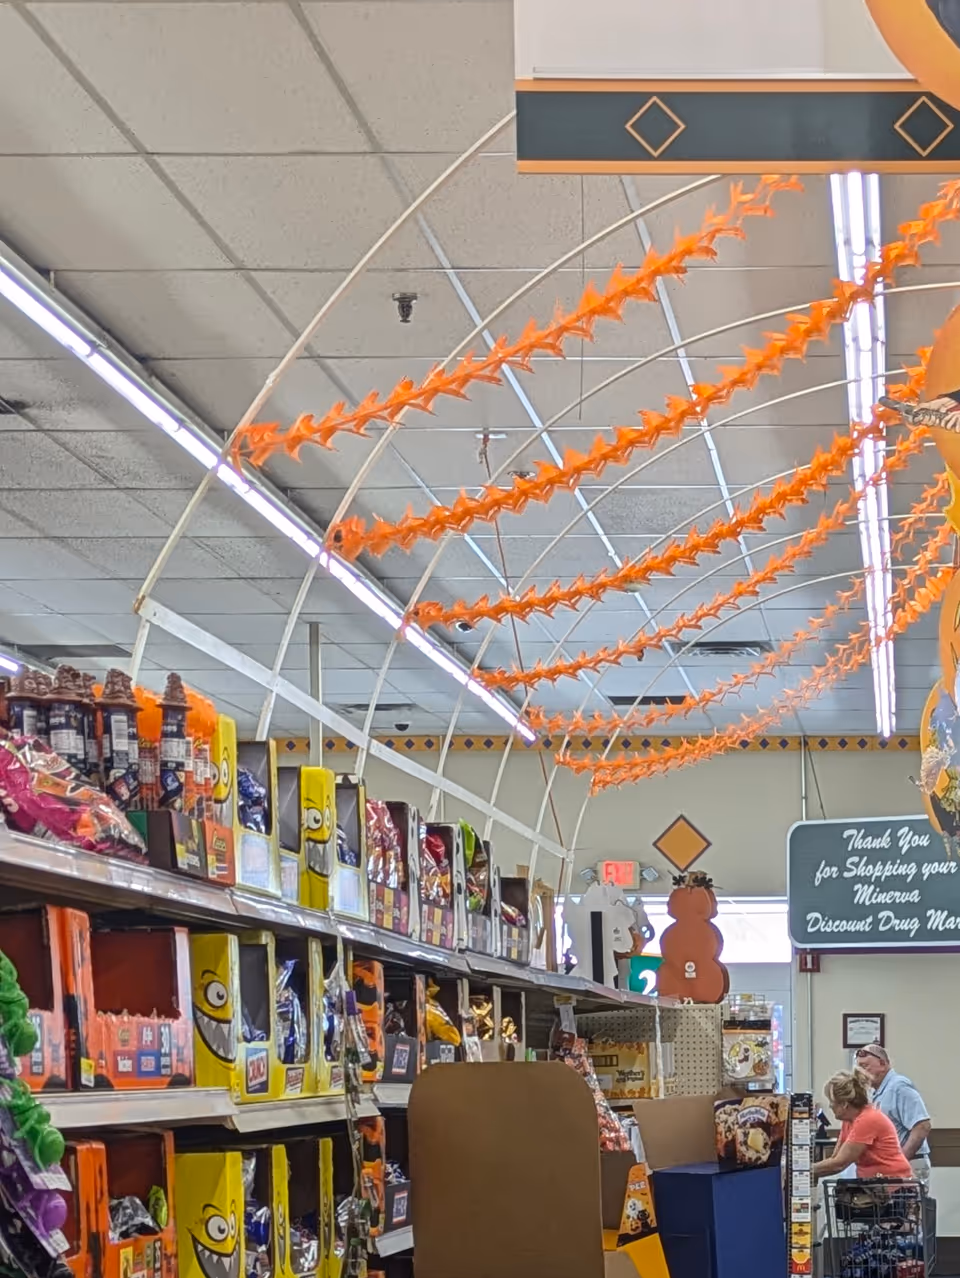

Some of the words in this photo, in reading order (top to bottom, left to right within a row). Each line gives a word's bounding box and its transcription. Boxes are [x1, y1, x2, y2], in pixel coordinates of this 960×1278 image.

[843, 828, 891, 851] Thank
[897, 827, 930, 855] You
[815, 860, 839, 886] for
[843, 857, 917, 883] Shopping
[921, 861, 958, 884] your
[854, 884, 921, 905] Minerva
[806, 912, 873, 933] Discount
[879, 911, 920, 937] Drug
